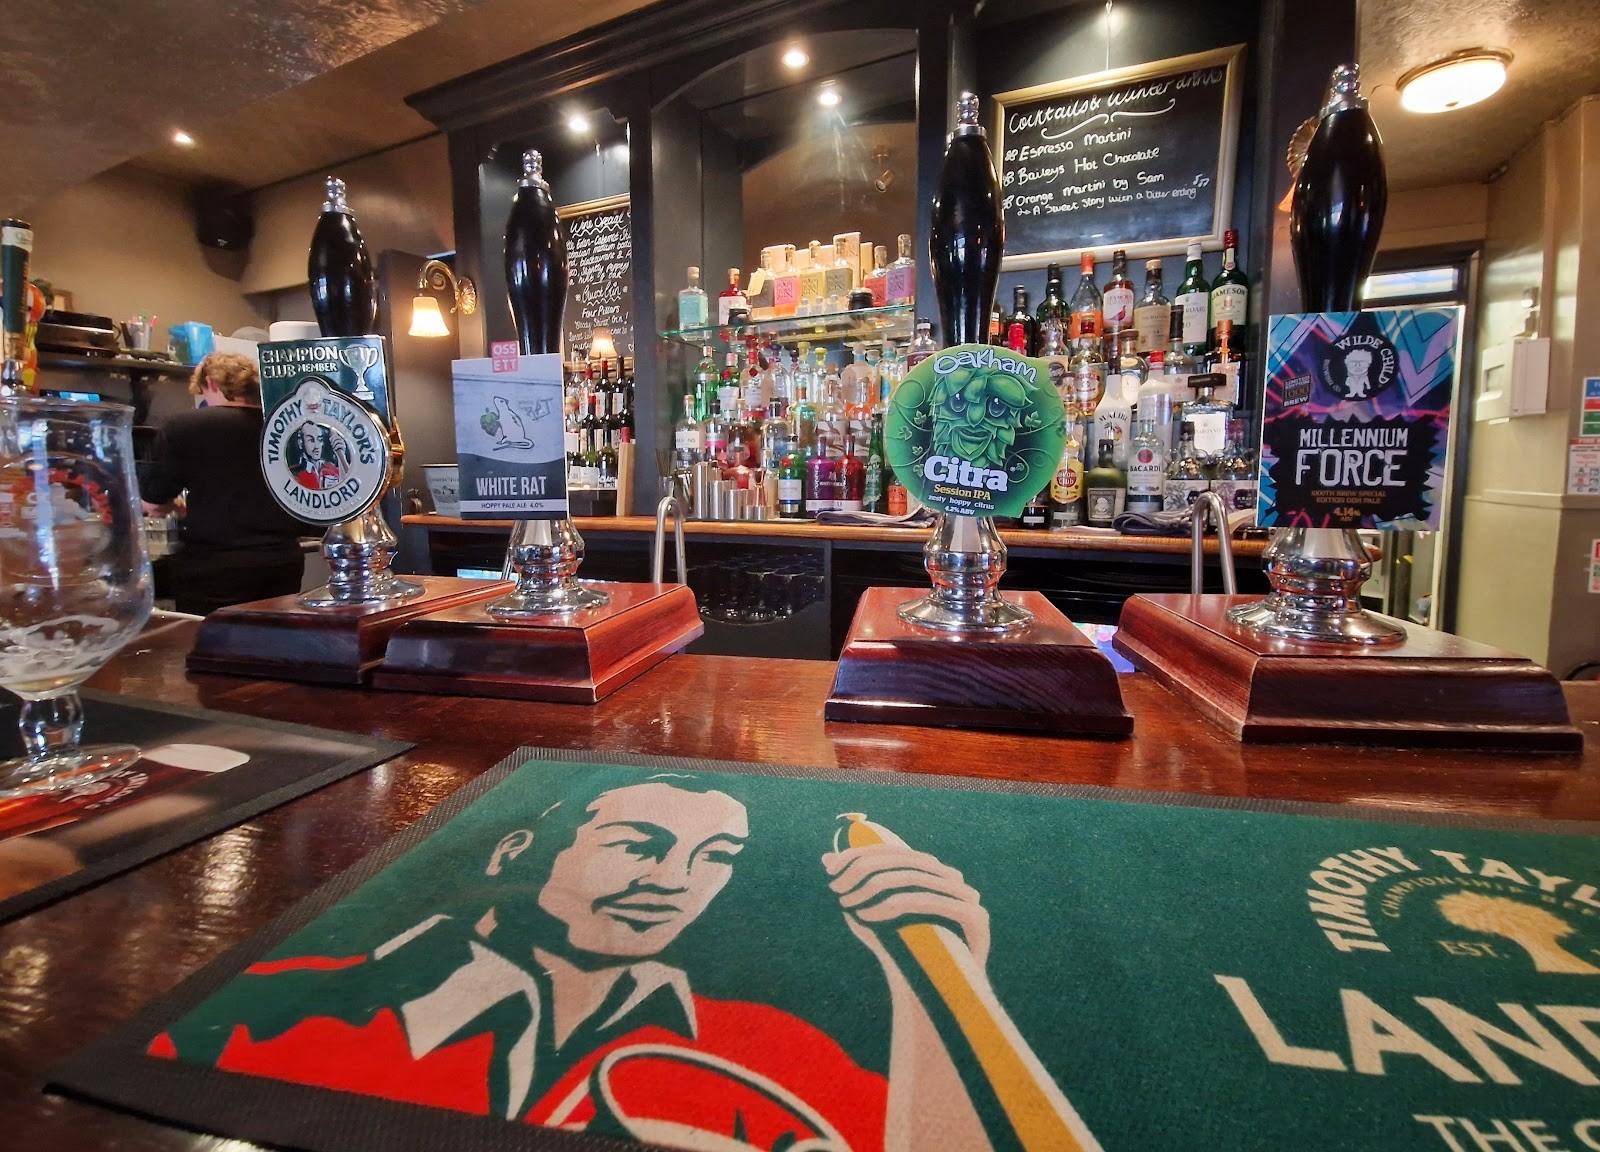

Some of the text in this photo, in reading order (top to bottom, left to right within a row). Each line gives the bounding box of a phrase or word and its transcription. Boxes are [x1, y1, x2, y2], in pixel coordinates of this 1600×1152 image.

[1107, 80, 1175, 107] Winter
[1019, 127, 1131, 161] Espresso Martini
[1018, 147, 1160, 185] Baileys Hot Chocolate
[1016, 171, 1165, 206] Orange Martini by Sam
[1032, 205, 1040, 215] A
[1136, 192, 1144, 200] a
[1212, 286, 1246, 299] JAMESON
[582, 308, 598, 318] Four
[262, 345, 339, 363] CHAMPION
[263, 362, 338, 379] CLUB MEMBER
[933, 348, 1037, 383] Oakham
[1334, 334, 1396, 385] WILDE CHILD
[267, 399, 376, 465] TIMOTHY TAYLOR'S
[1299, 428, 1409, 448] MILLENNIUM
[924, 455, 1008, 492] Citra
[1295, 449, 1408, 488] FORCE
[283, 477, 361, 510] LANDLORD
[476, 476, 547, 497] WHITE RAT
[928, 495, 995, 510] zesty hoppy citrus
[934, 484, 991, 500] Session IPA
[1306, 846, 1422, 952] TIMOTHY
[1412, 1114, 1571, 1152] THE
